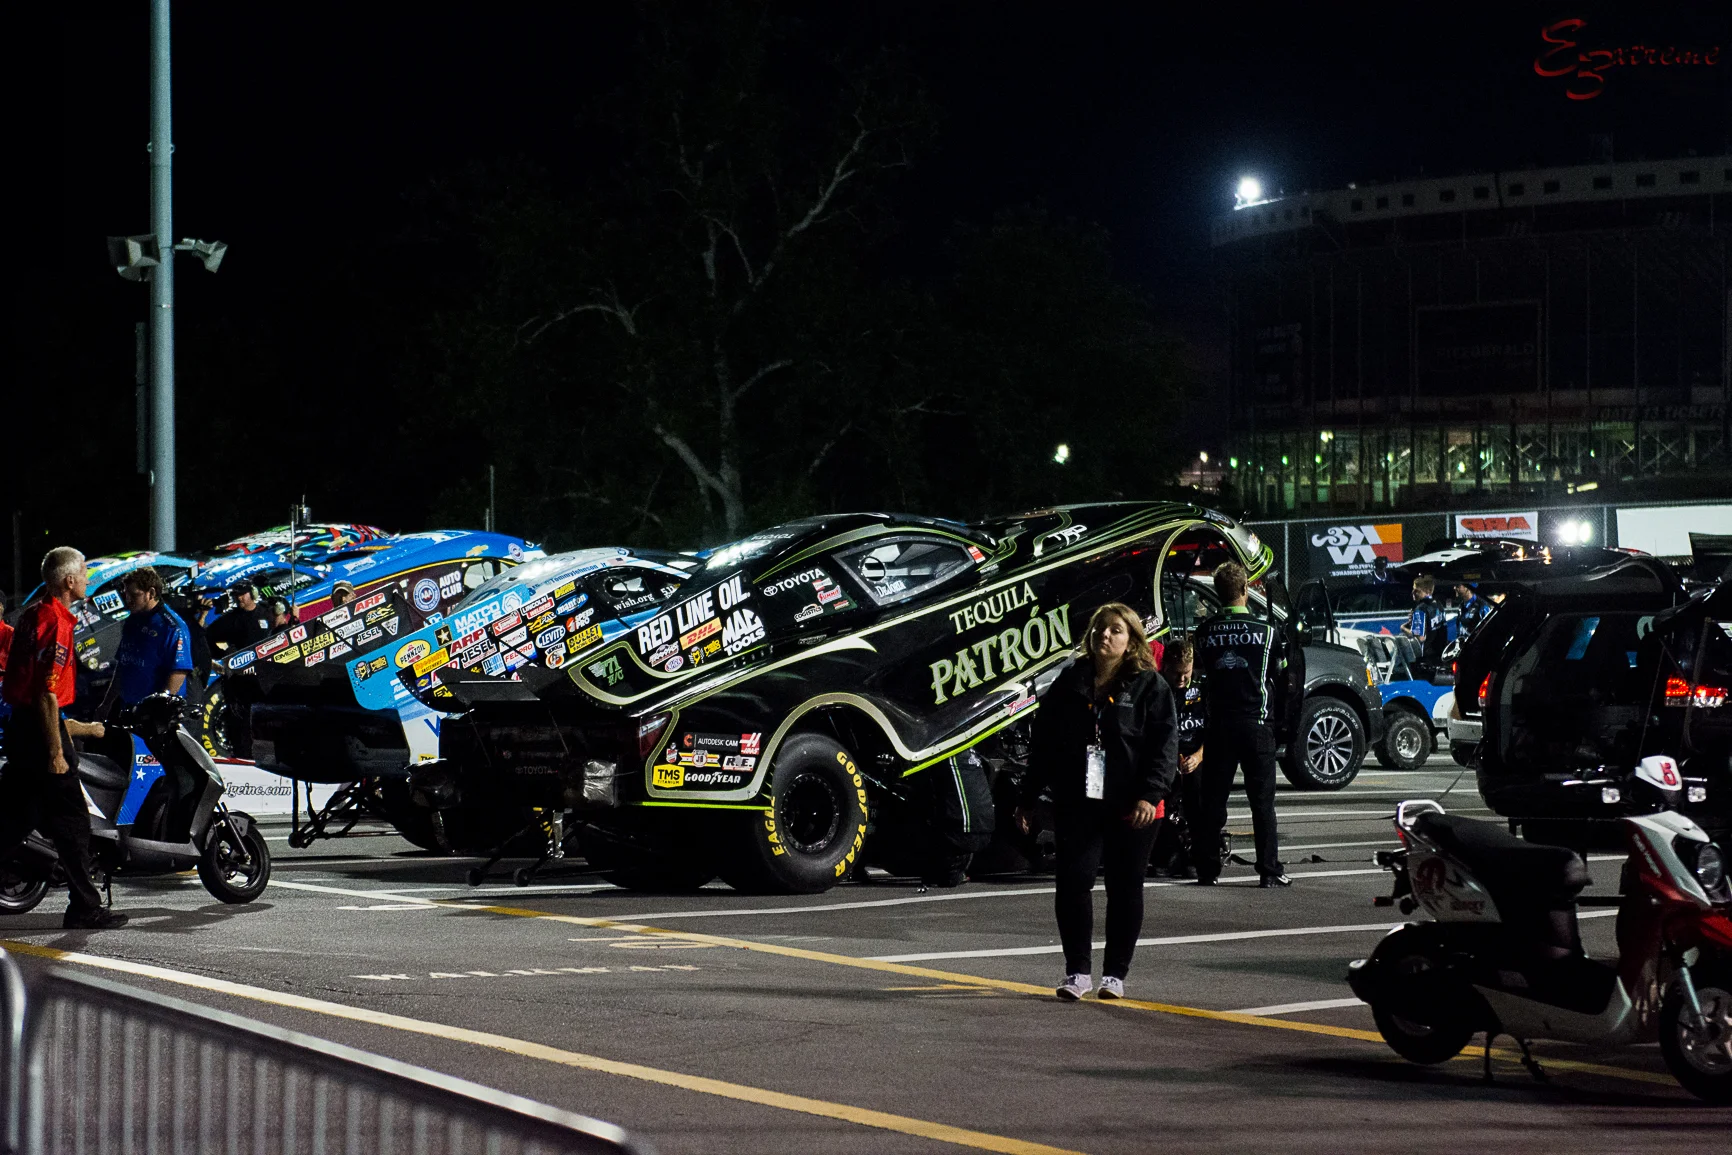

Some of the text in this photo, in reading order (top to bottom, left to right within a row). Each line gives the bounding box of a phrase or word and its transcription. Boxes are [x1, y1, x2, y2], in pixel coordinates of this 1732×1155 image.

[225, 561, 275, 586] JOHN FORCE
[440, 570, 461, 589] AUTO
[776, 568, 825, 592] TOYOTA
[94, 592, 118, 604] Blue
[441, 582, 462, 599] CLUB
[354, 593, 384, 612] ARP
[521, 595, 548, 613] LINCOLN
[557, 594, 587, 615] manton
[614, 593, 655, 612] wish.org
[949, 581, 1038, 635] TEQUILA
[455, 601, 500, 633] MATCO
[638, 575, 748, 655] RED LINE OIL
[292, 629, 303, 639] CV
[357, 627, 380, 643] JESEL
[569, 624, 599, 648] BULLET
[687, 624, 716, 645] DHL
[722, 609, 764, 648] MAC
[1208, 623, 1249, 632] TEQUILA
[302, 631, 333, 651] BULLET
[452, 627, 485, 654] ARP
[724, 627, 766, 656] TOOLS
[306, 651, 324, 664] MSD
[400, 643, 426, 665] PENNZOIL
[462, 640, 494, 663] JESEL
[929, 603, 1072, 706] PATRÓN
[697, 737, 738, 747] AUTODESK CAM
[657, 769, 681, 781] TMS
[684, 772, 741, 785] GOODYEAR
[764, 796, 785, 856] EAGLE
